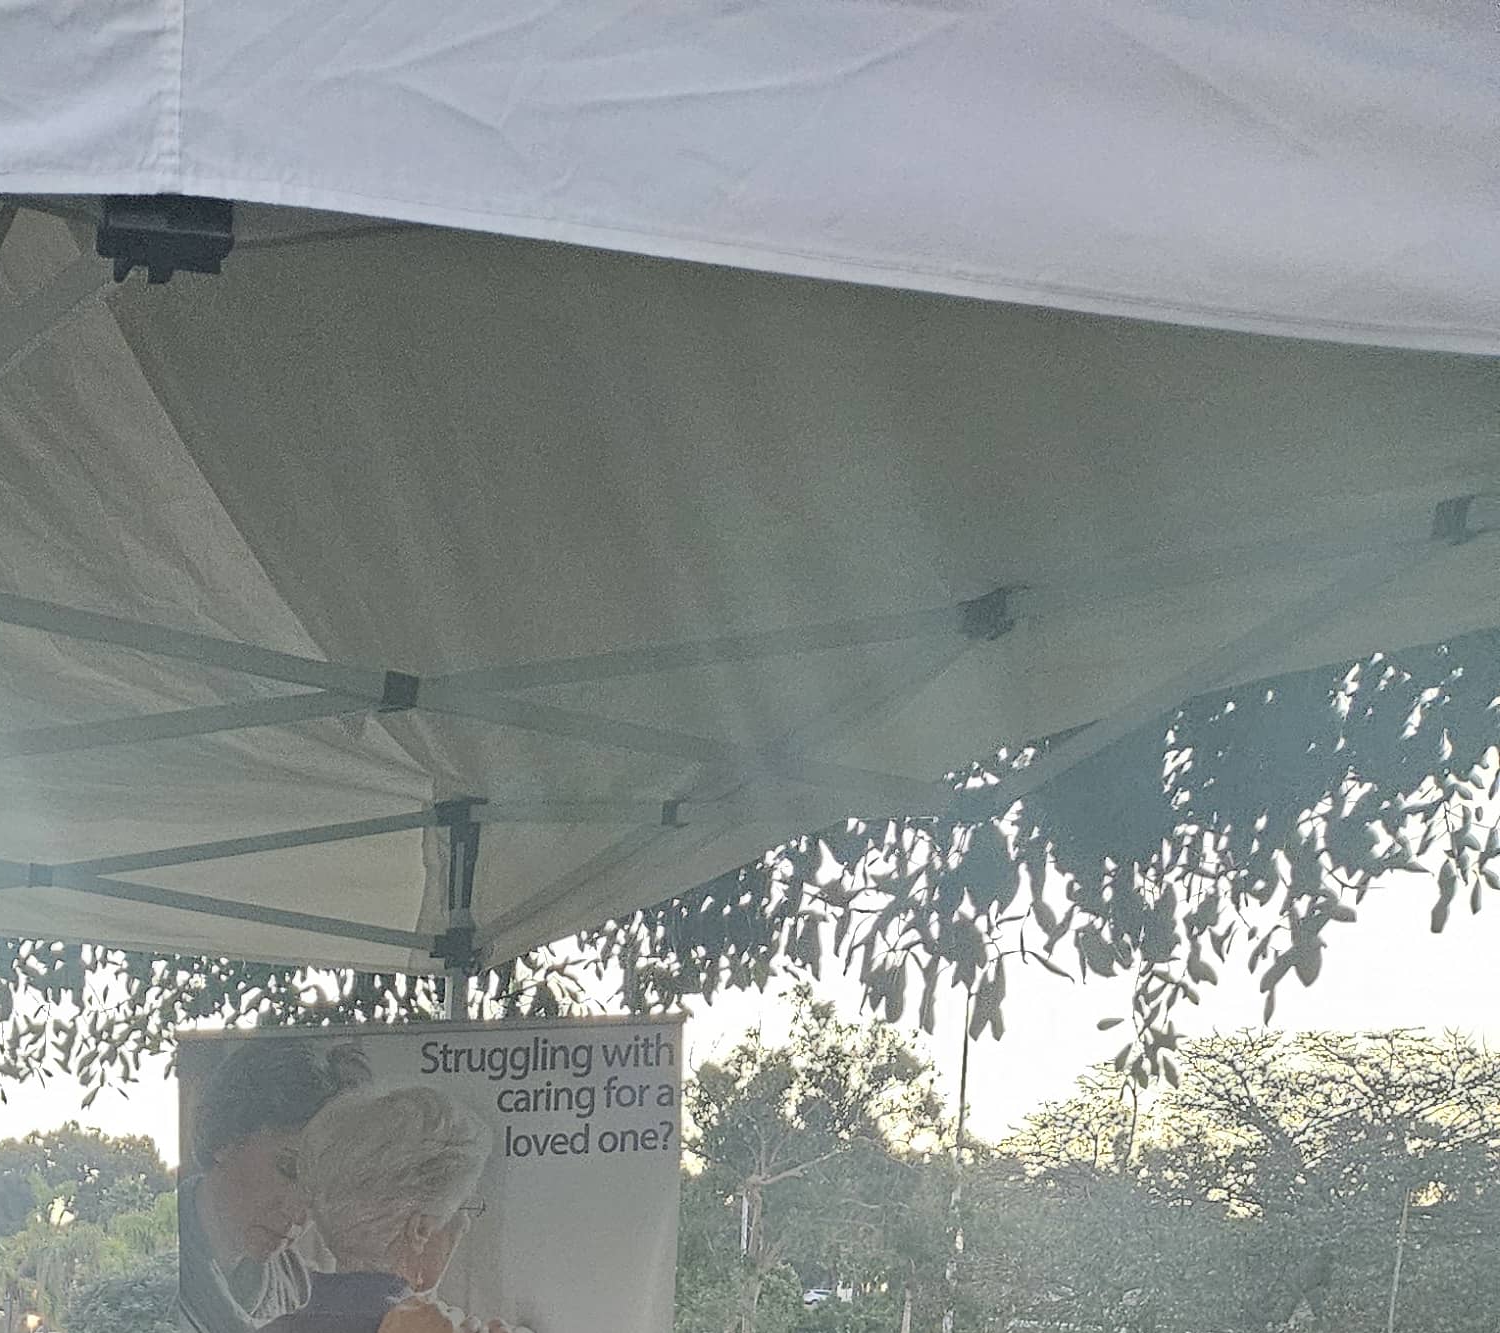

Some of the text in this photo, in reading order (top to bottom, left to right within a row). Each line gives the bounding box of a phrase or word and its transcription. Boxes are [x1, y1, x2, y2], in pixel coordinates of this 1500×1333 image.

[421, 1033, 674, 1080] Struggling with
[497, 1076, 674, 1118] caring for a
[506, 1121, 673, 1157] loved one?
